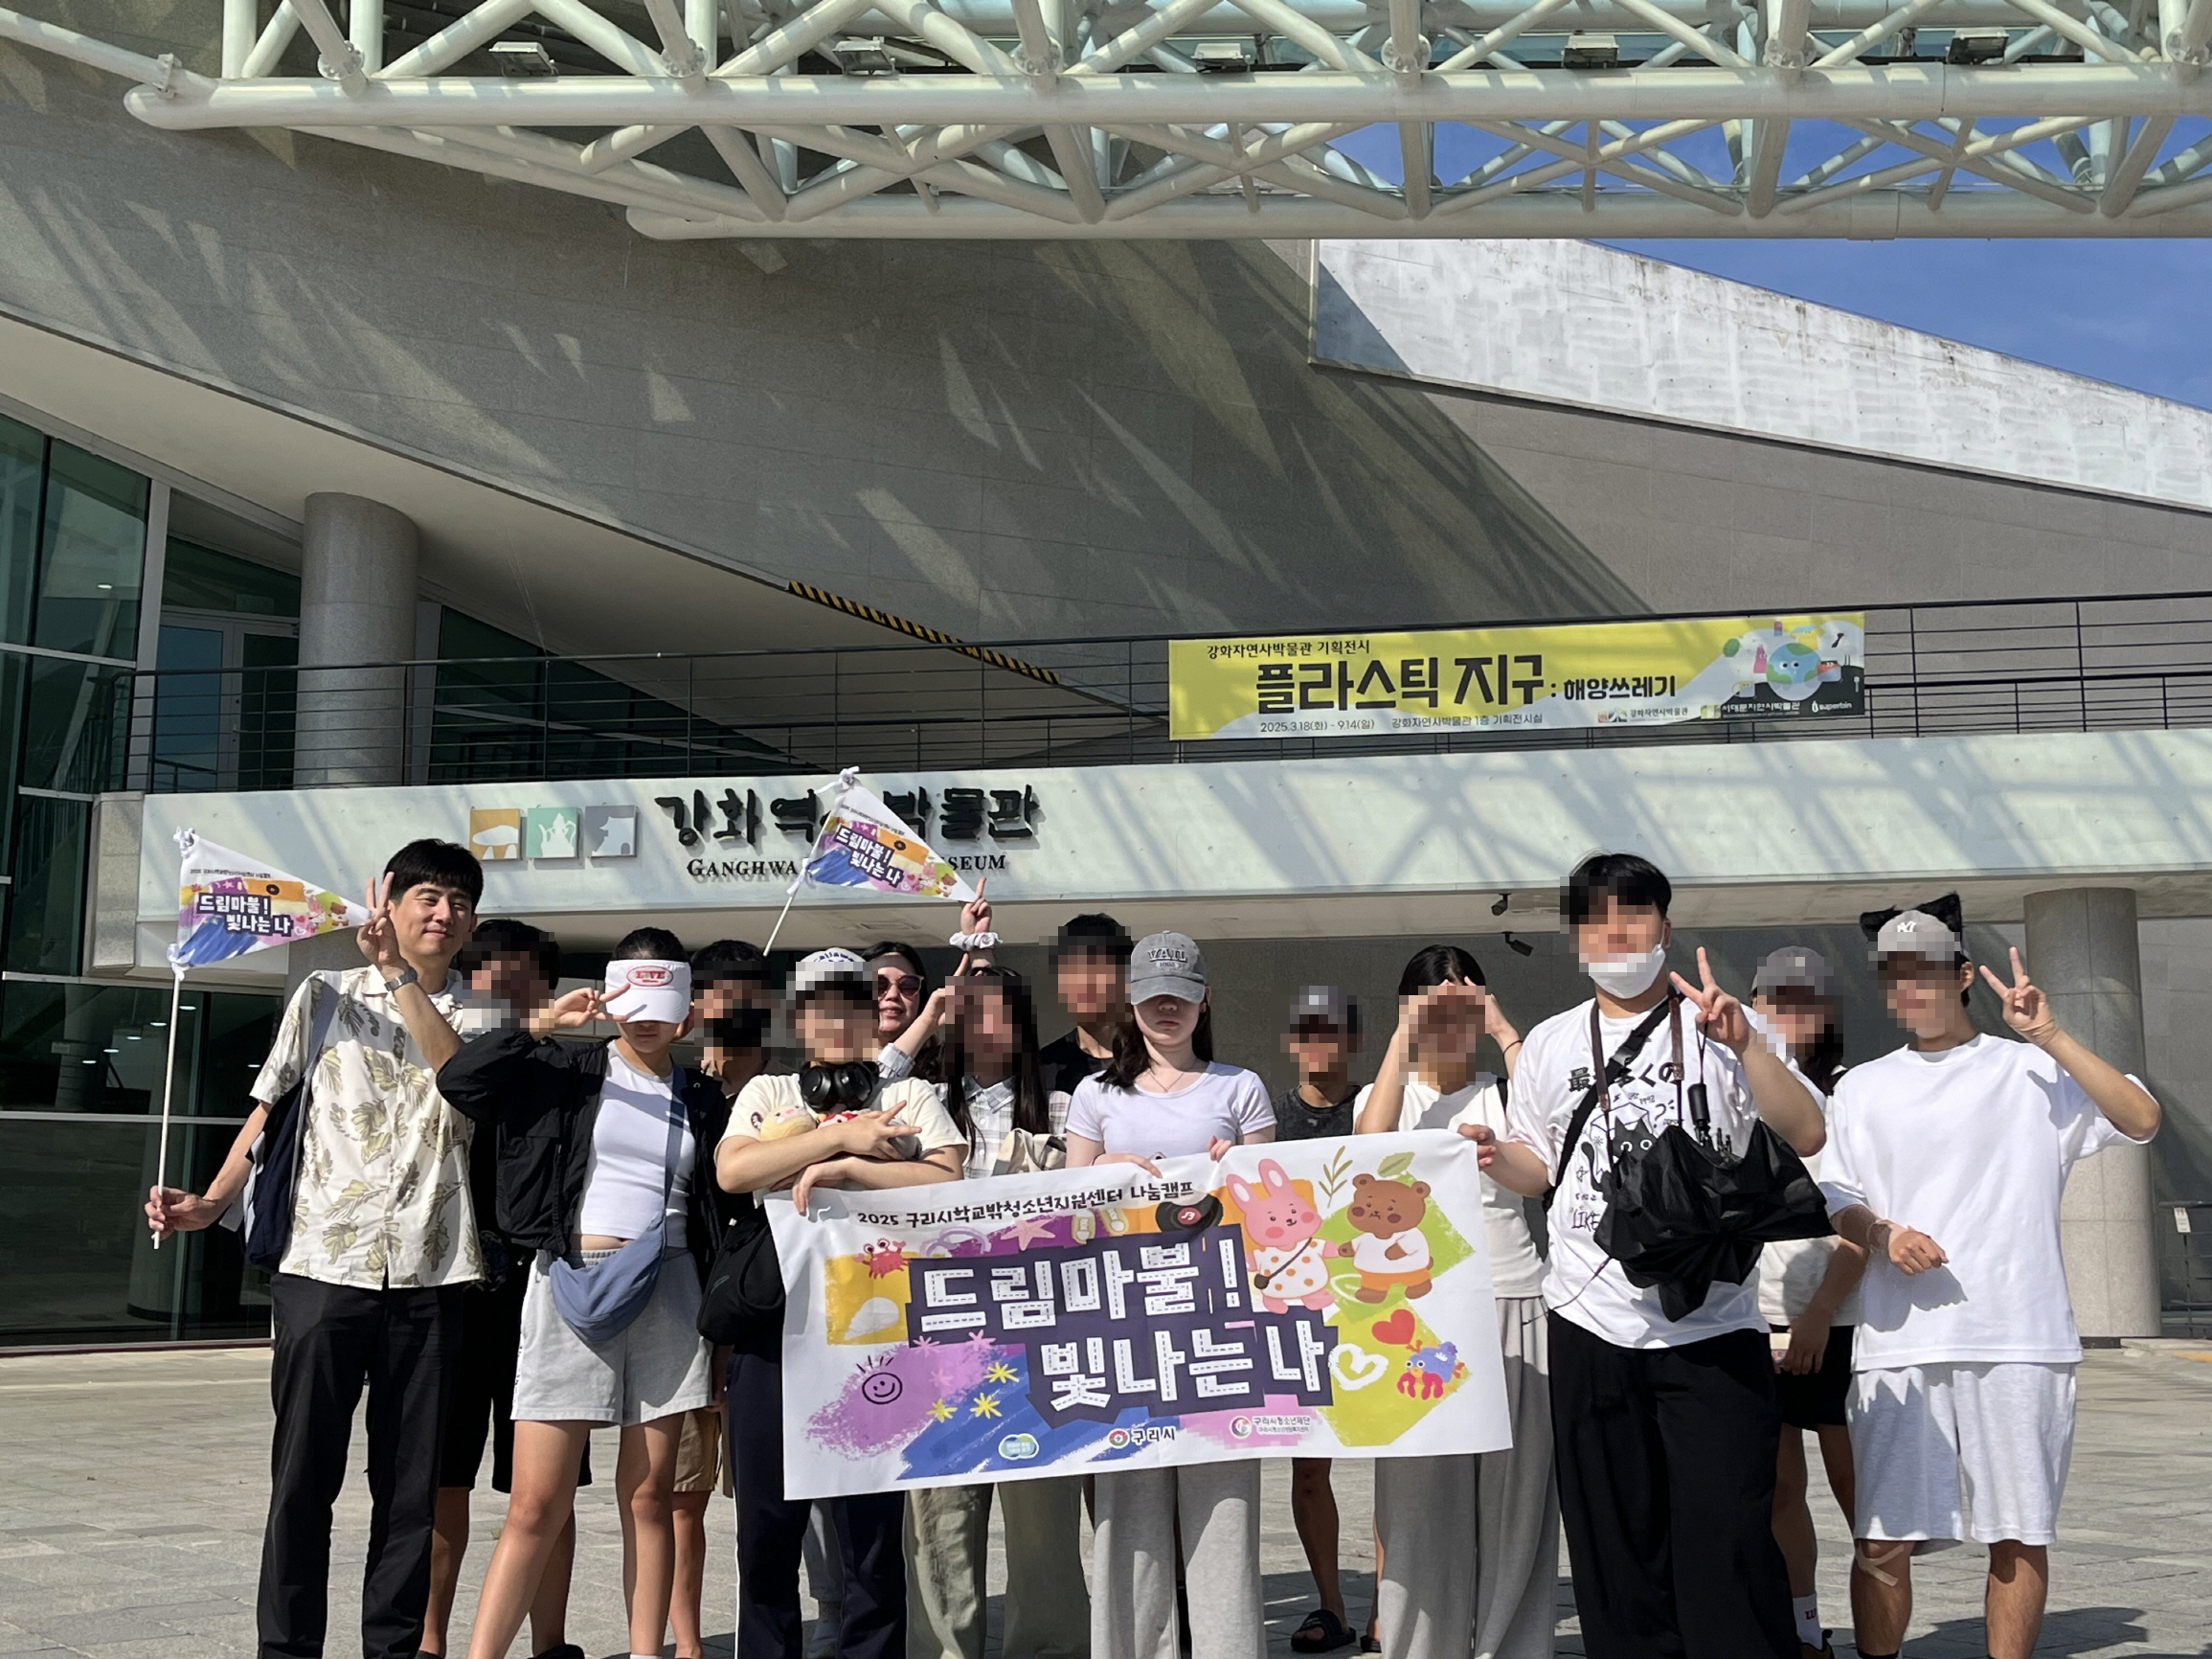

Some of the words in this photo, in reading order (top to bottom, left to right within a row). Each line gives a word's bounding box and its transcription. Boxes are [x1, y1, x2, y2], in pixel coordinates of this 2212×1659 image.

[1207, 641, 1313, 660] 강화자연사박물관
[1317, 639, 1370, 655] 기획전시
[1255, 656, 1439, 715] 플라스틱
[1564, 675, 1676, 701] 해양쓰레기
[1260, 720, 1328, 734] 2025.3.18(화)
[1391, 716, 1472, 728] 강화자연사박물관
[1493, 713, 1543, 725] 기획전시실
[654, 784, 1040, 847] 강화역박물관
[687, 858, 799, 876] GANGHWA
[857, 1212, 899, 1226] 2025
[905, 1186, 1123, 1229] 구리시학교밖청소년지원센터
[1130, 1181, 1194, 1201] 나눔캠프
[920, 1238, 1241, 1332] 드림마불!
[1041, 1328, 1253, 1413] 빛나는
[1265, 1320, 1324, 1392] 나
[1132, 1427, 1175, 1443] 구리시
